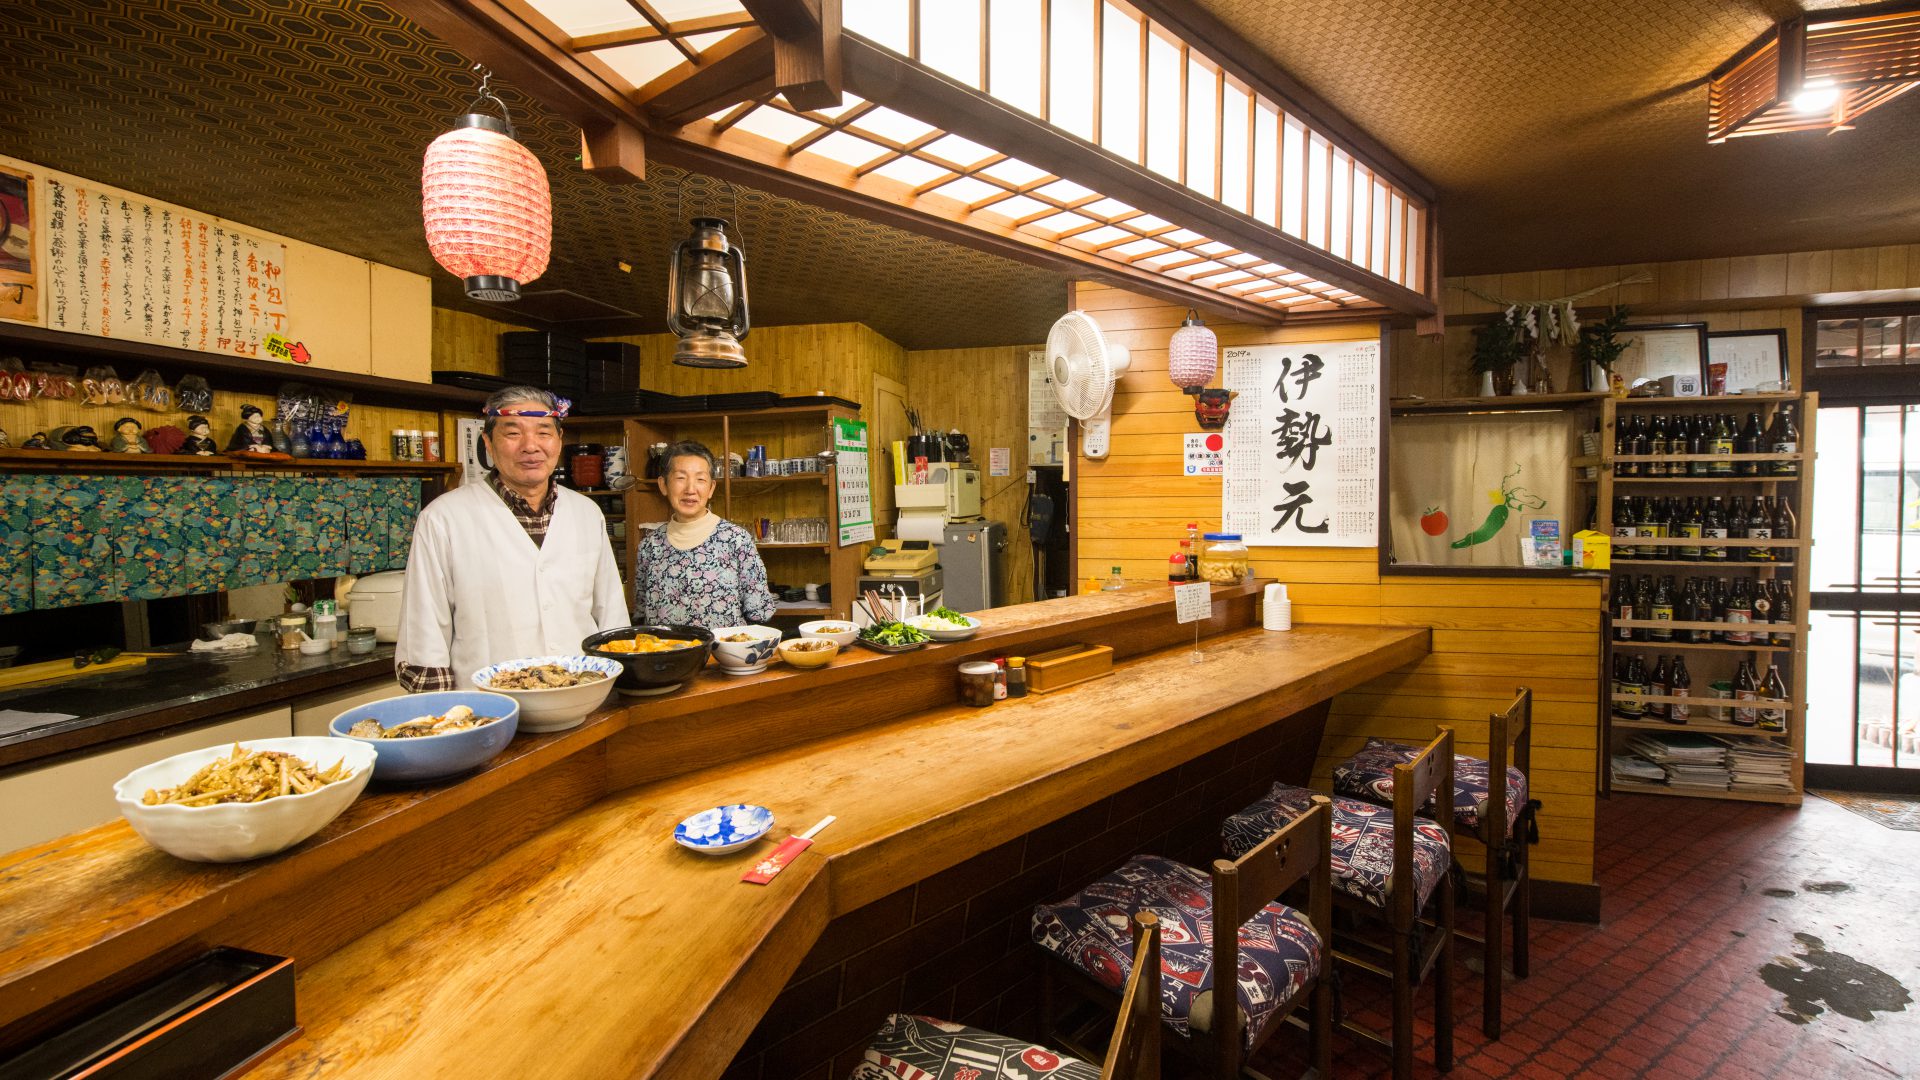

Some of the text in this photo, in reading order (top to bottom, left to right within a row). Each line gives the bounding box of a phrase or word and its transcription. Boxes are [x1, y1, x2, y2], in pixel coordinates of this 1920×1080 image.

[264, 259, 287, 332] 押包丁
[1681, 384, 1693, 393] 80
[1271, 353, 1332, 534] 伊勢元
